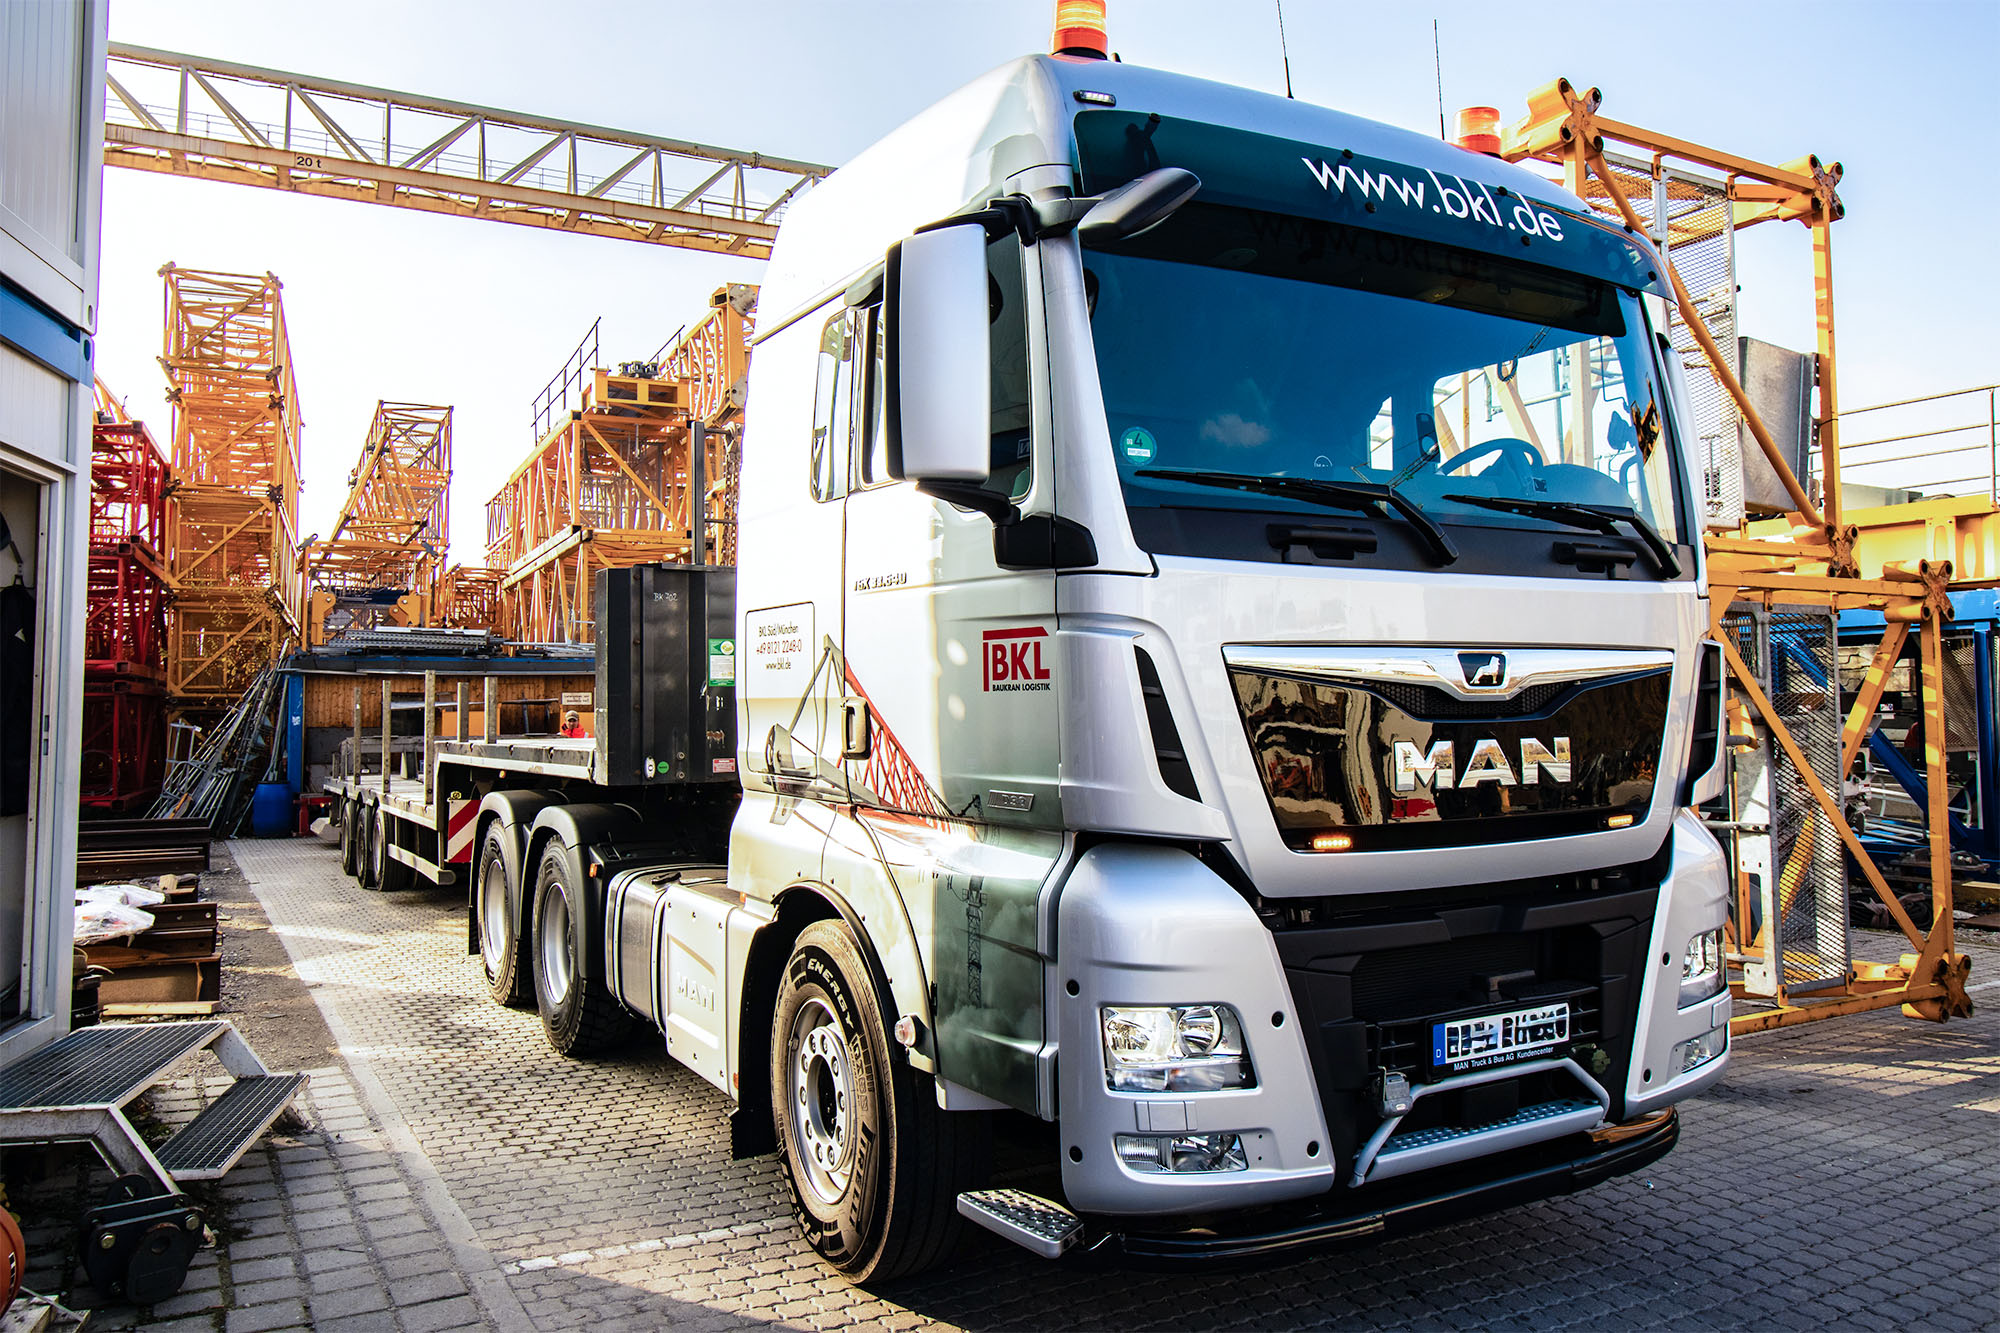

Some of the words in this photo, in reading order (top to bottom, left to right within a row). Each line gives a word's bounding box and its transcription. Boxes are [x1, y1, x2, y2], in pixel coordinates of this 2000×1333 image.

[297, 156, 313, 167] 20
[316, 159, 322, 168] t
[1301, 157, 1564, 242] www.bkl.de
[1134, 432, 1143, 447] 4
[758, 625, 767, 638] BKL
[756, 642, 766, 655] +49
[765, 657, 792, 670] www.bkl.de
[992, 641, 1051, 681] BKL
[992, 684, 1021, 692] BAUKRAN
[1022, 682, 1051, 691] LOGISTIK
[1394, 736, 1571, 792] MAN
[807, 958, 854, 1029] ENERGY
[1435, 1049, 1442, 1058] D
[1453, 1060, 1469, 1071] MAN
[1471, 1059, 1487, 1068] Truck
[1487, 1057, 1492, 1065] &
[1493, 1055, 1505, 1064] Bus
[1505, 1052, 1515, 1061] AG
[1516, 1046, 1554, 1059] Kundencenter
[849, 1120, 876, 1235] PIRELLI
